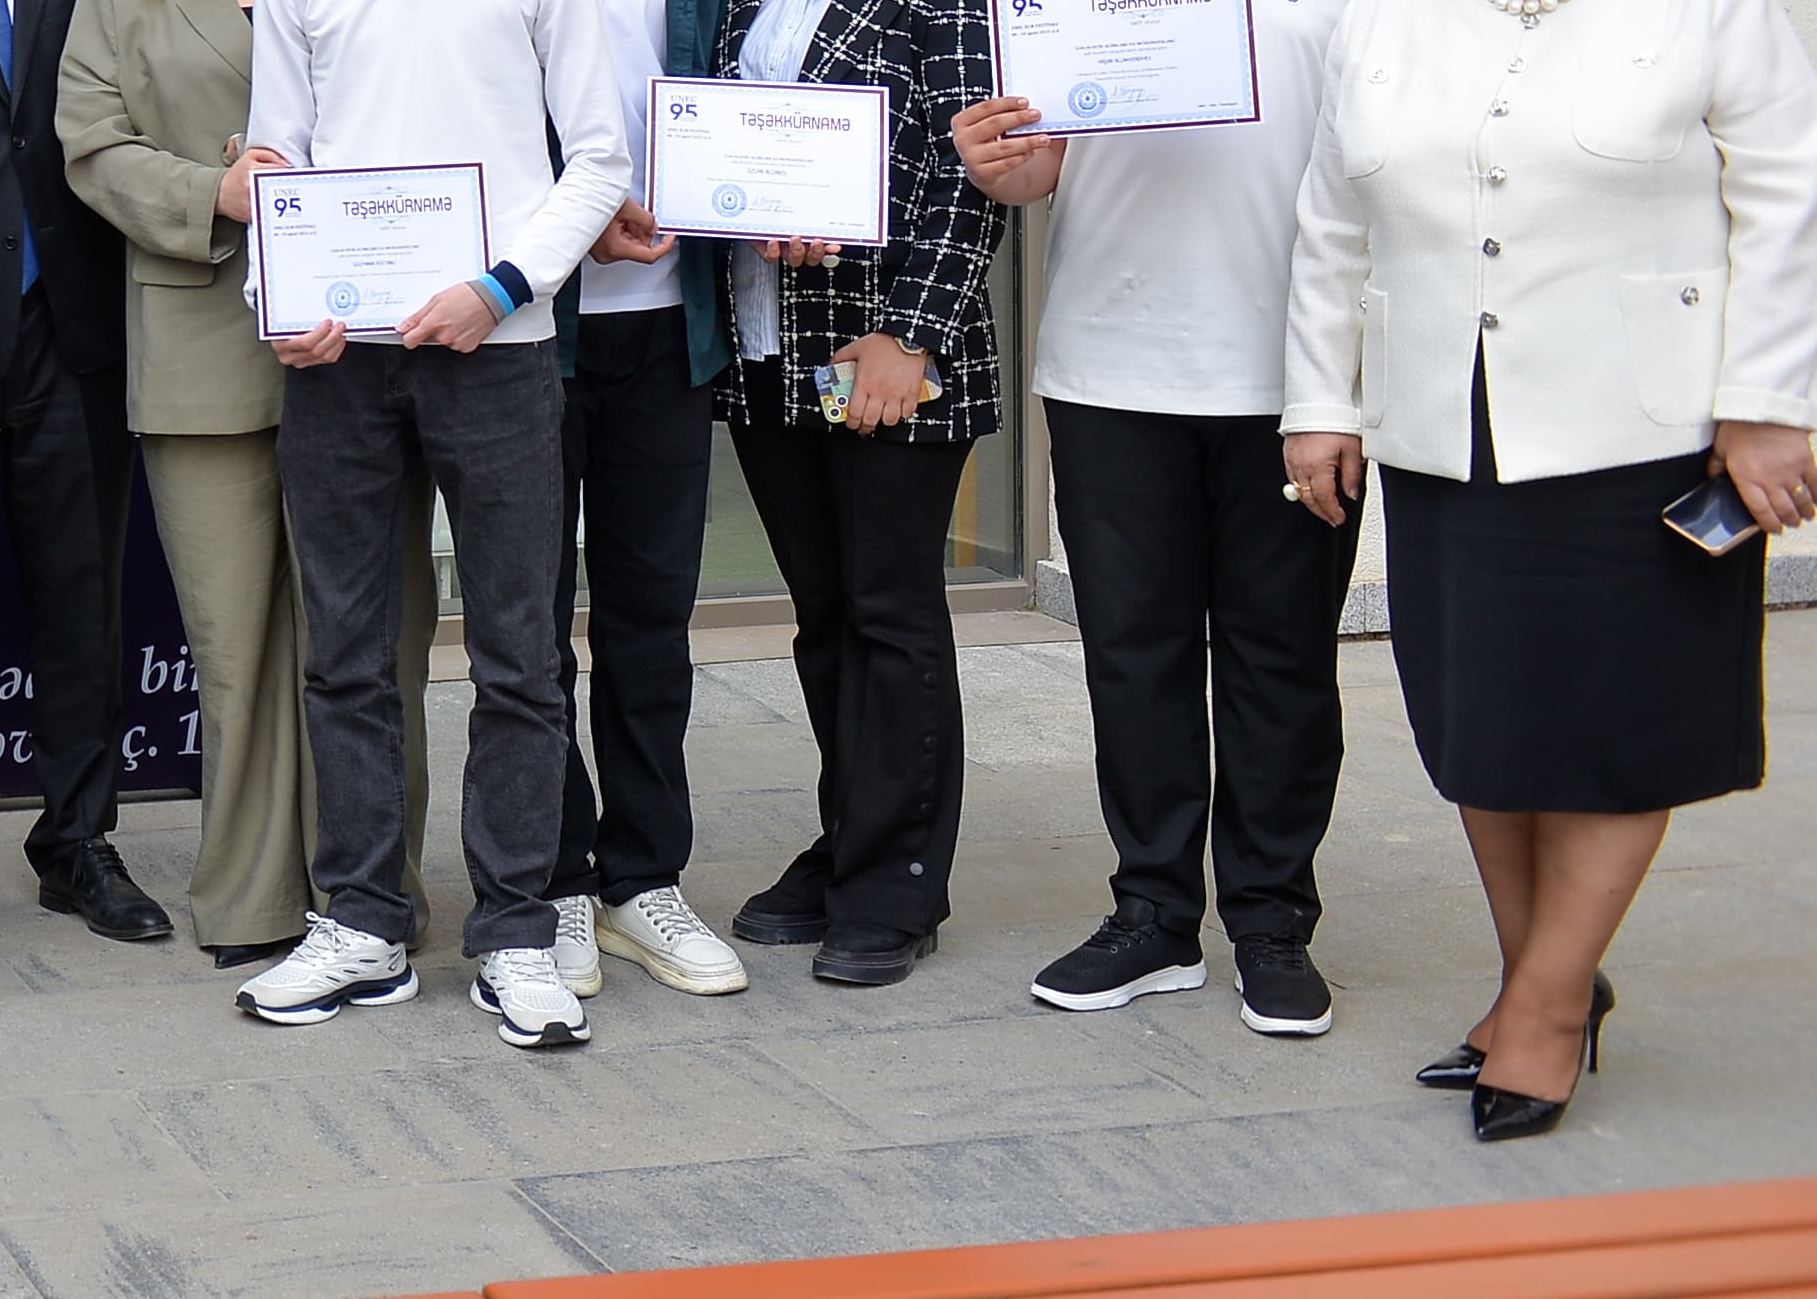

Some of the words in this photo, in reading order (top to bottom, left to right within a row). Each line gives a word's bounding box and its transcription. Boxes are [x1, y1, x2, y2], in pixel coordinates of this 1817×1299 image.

[670, 103, 698, 121] 95
[740, 111, 851, 132] TƏŞƏKKÜRNAMƏ
[274, 198, 302, 218] 95
[342, 195, 453, 220] TƏŞƏKKÜRNAMƏ
